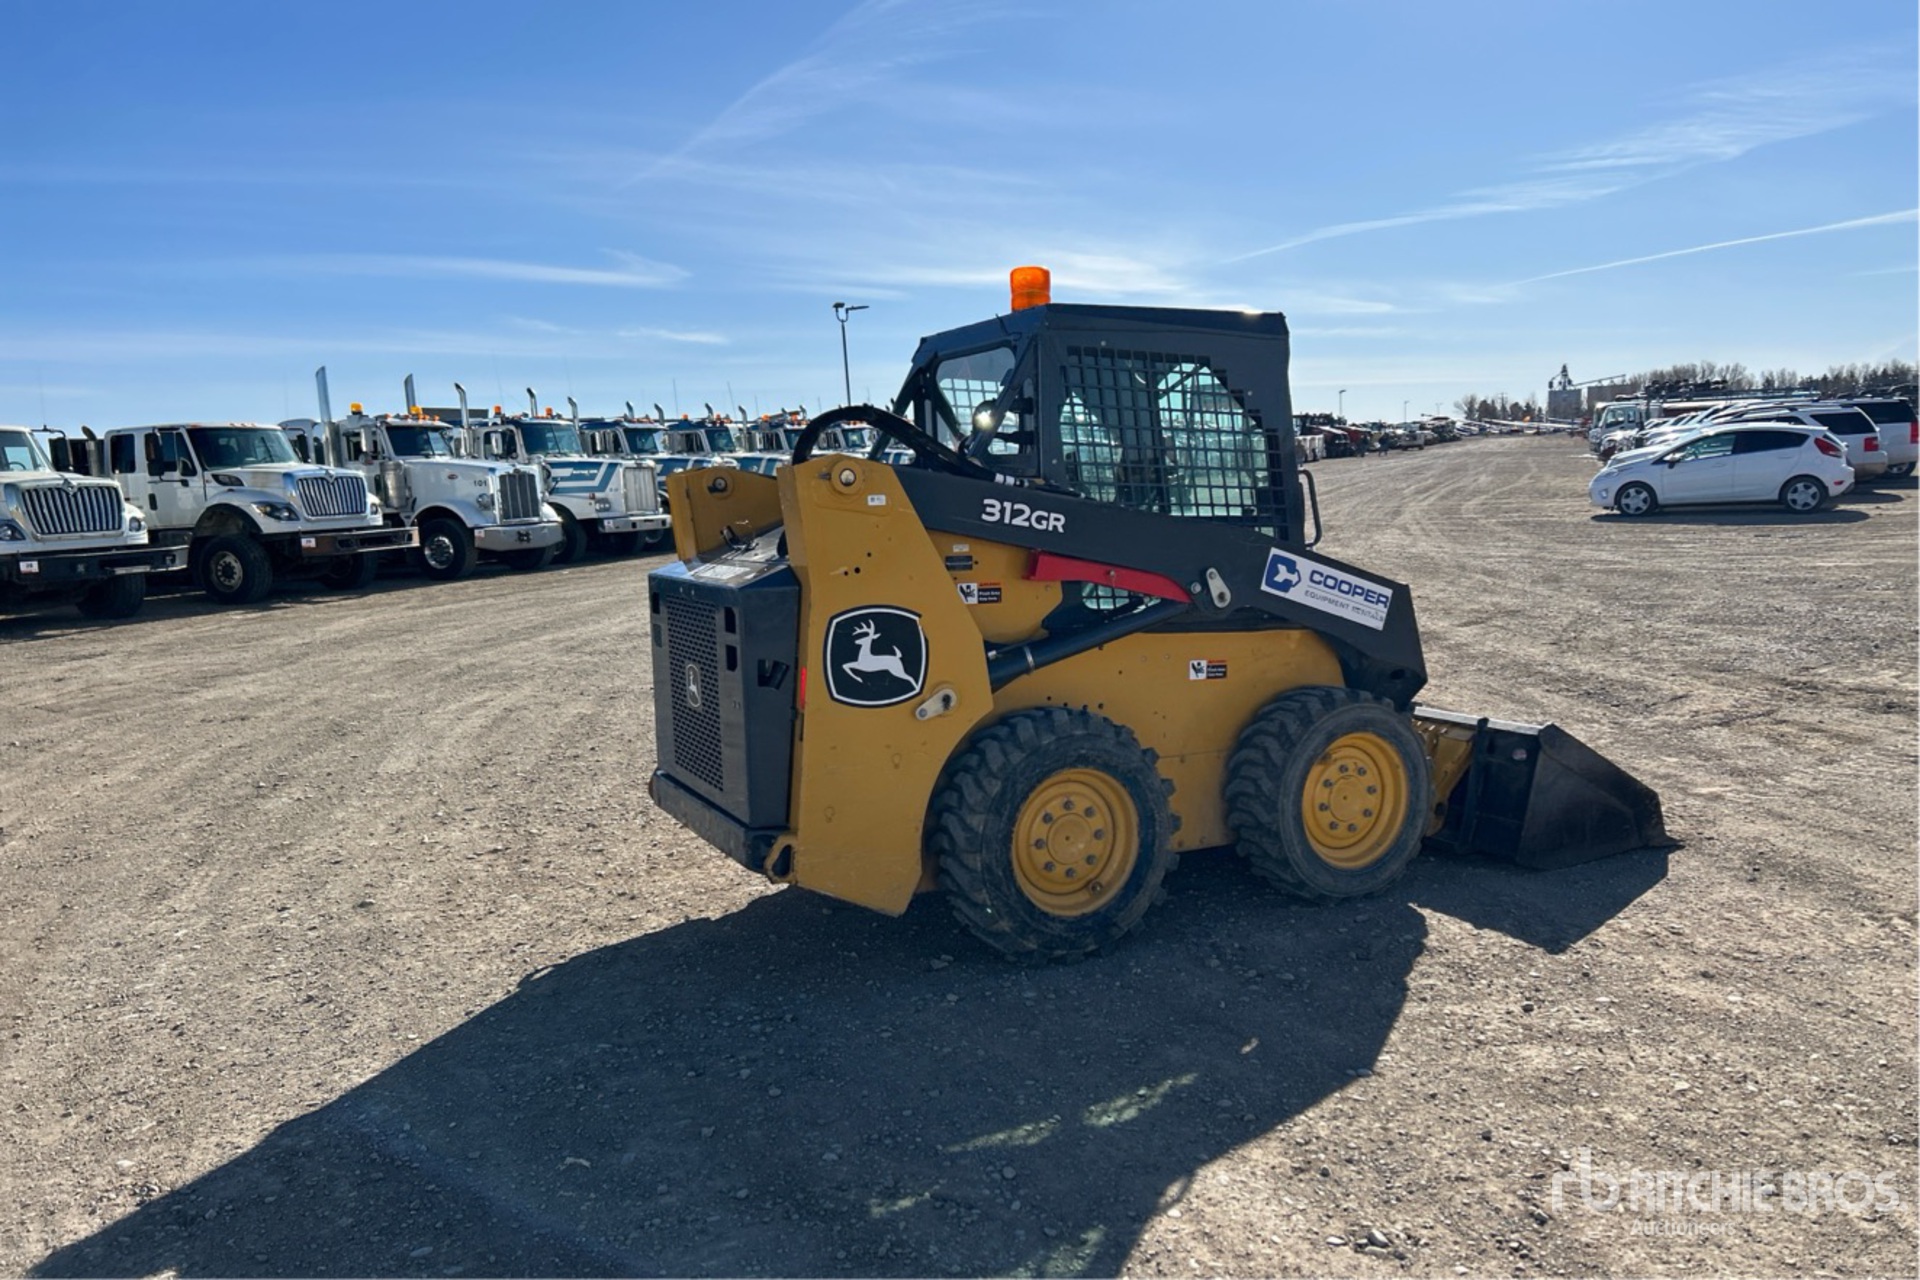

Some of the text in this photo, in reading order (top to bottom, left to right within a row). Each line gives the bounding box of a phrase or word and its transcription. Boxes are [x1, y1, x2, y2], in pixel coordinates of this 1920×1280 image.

[981, 498, 1066, 533] 312GR
[1304, 590, 1384, 622] EQUIPMENT RENTALS
[1309, 569, 1390, 608] COOPER
